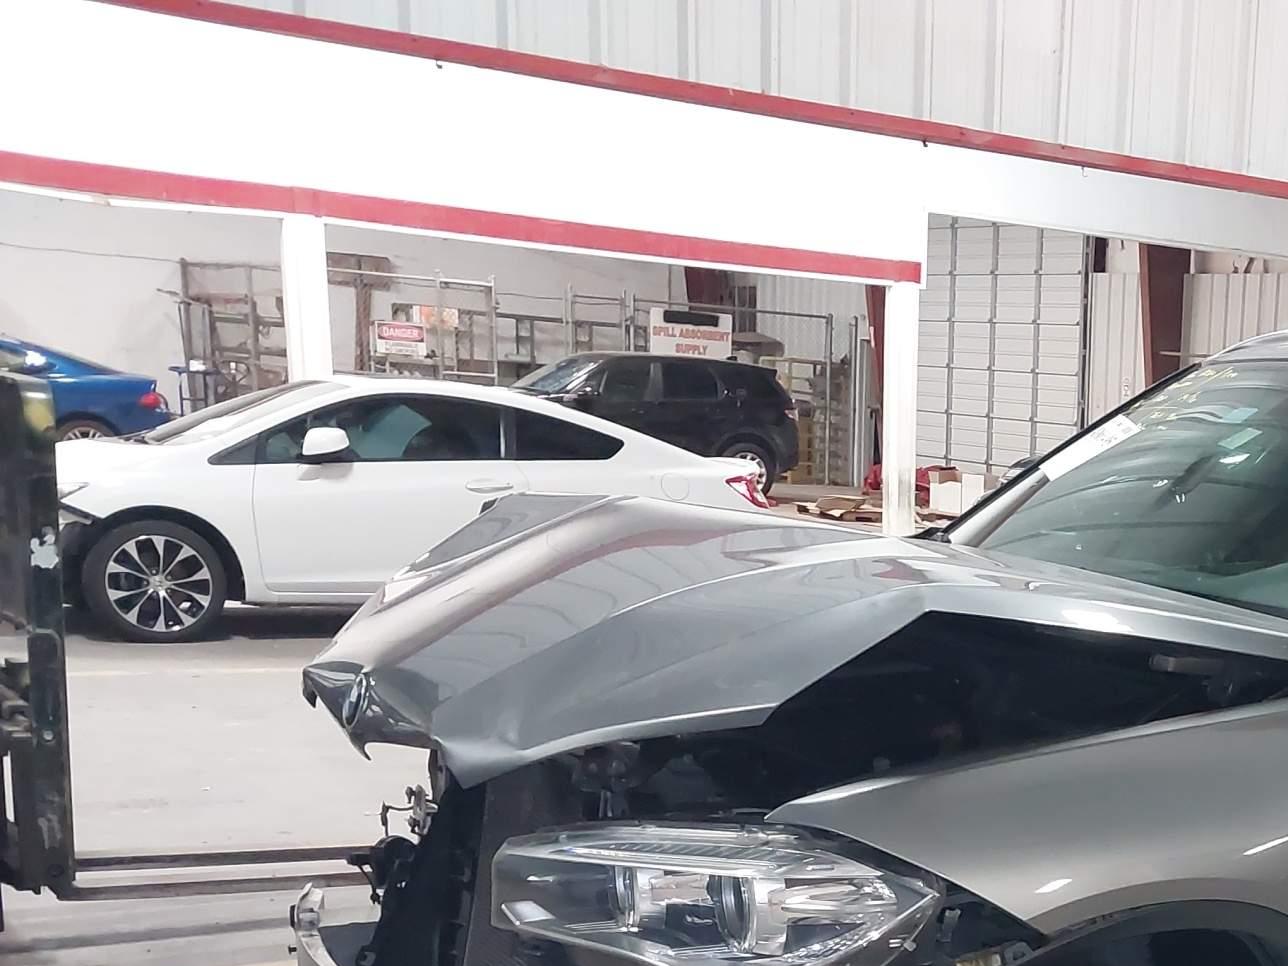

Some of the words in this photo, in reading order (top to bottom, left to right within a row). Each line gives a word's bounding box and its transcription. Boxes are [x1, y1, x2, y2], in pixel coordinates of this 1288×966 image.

[382, 326, 419, 338] DANGER
[652, 326, 677, 337] SPILL
[675, 343, 708, 355] SUPPLY
